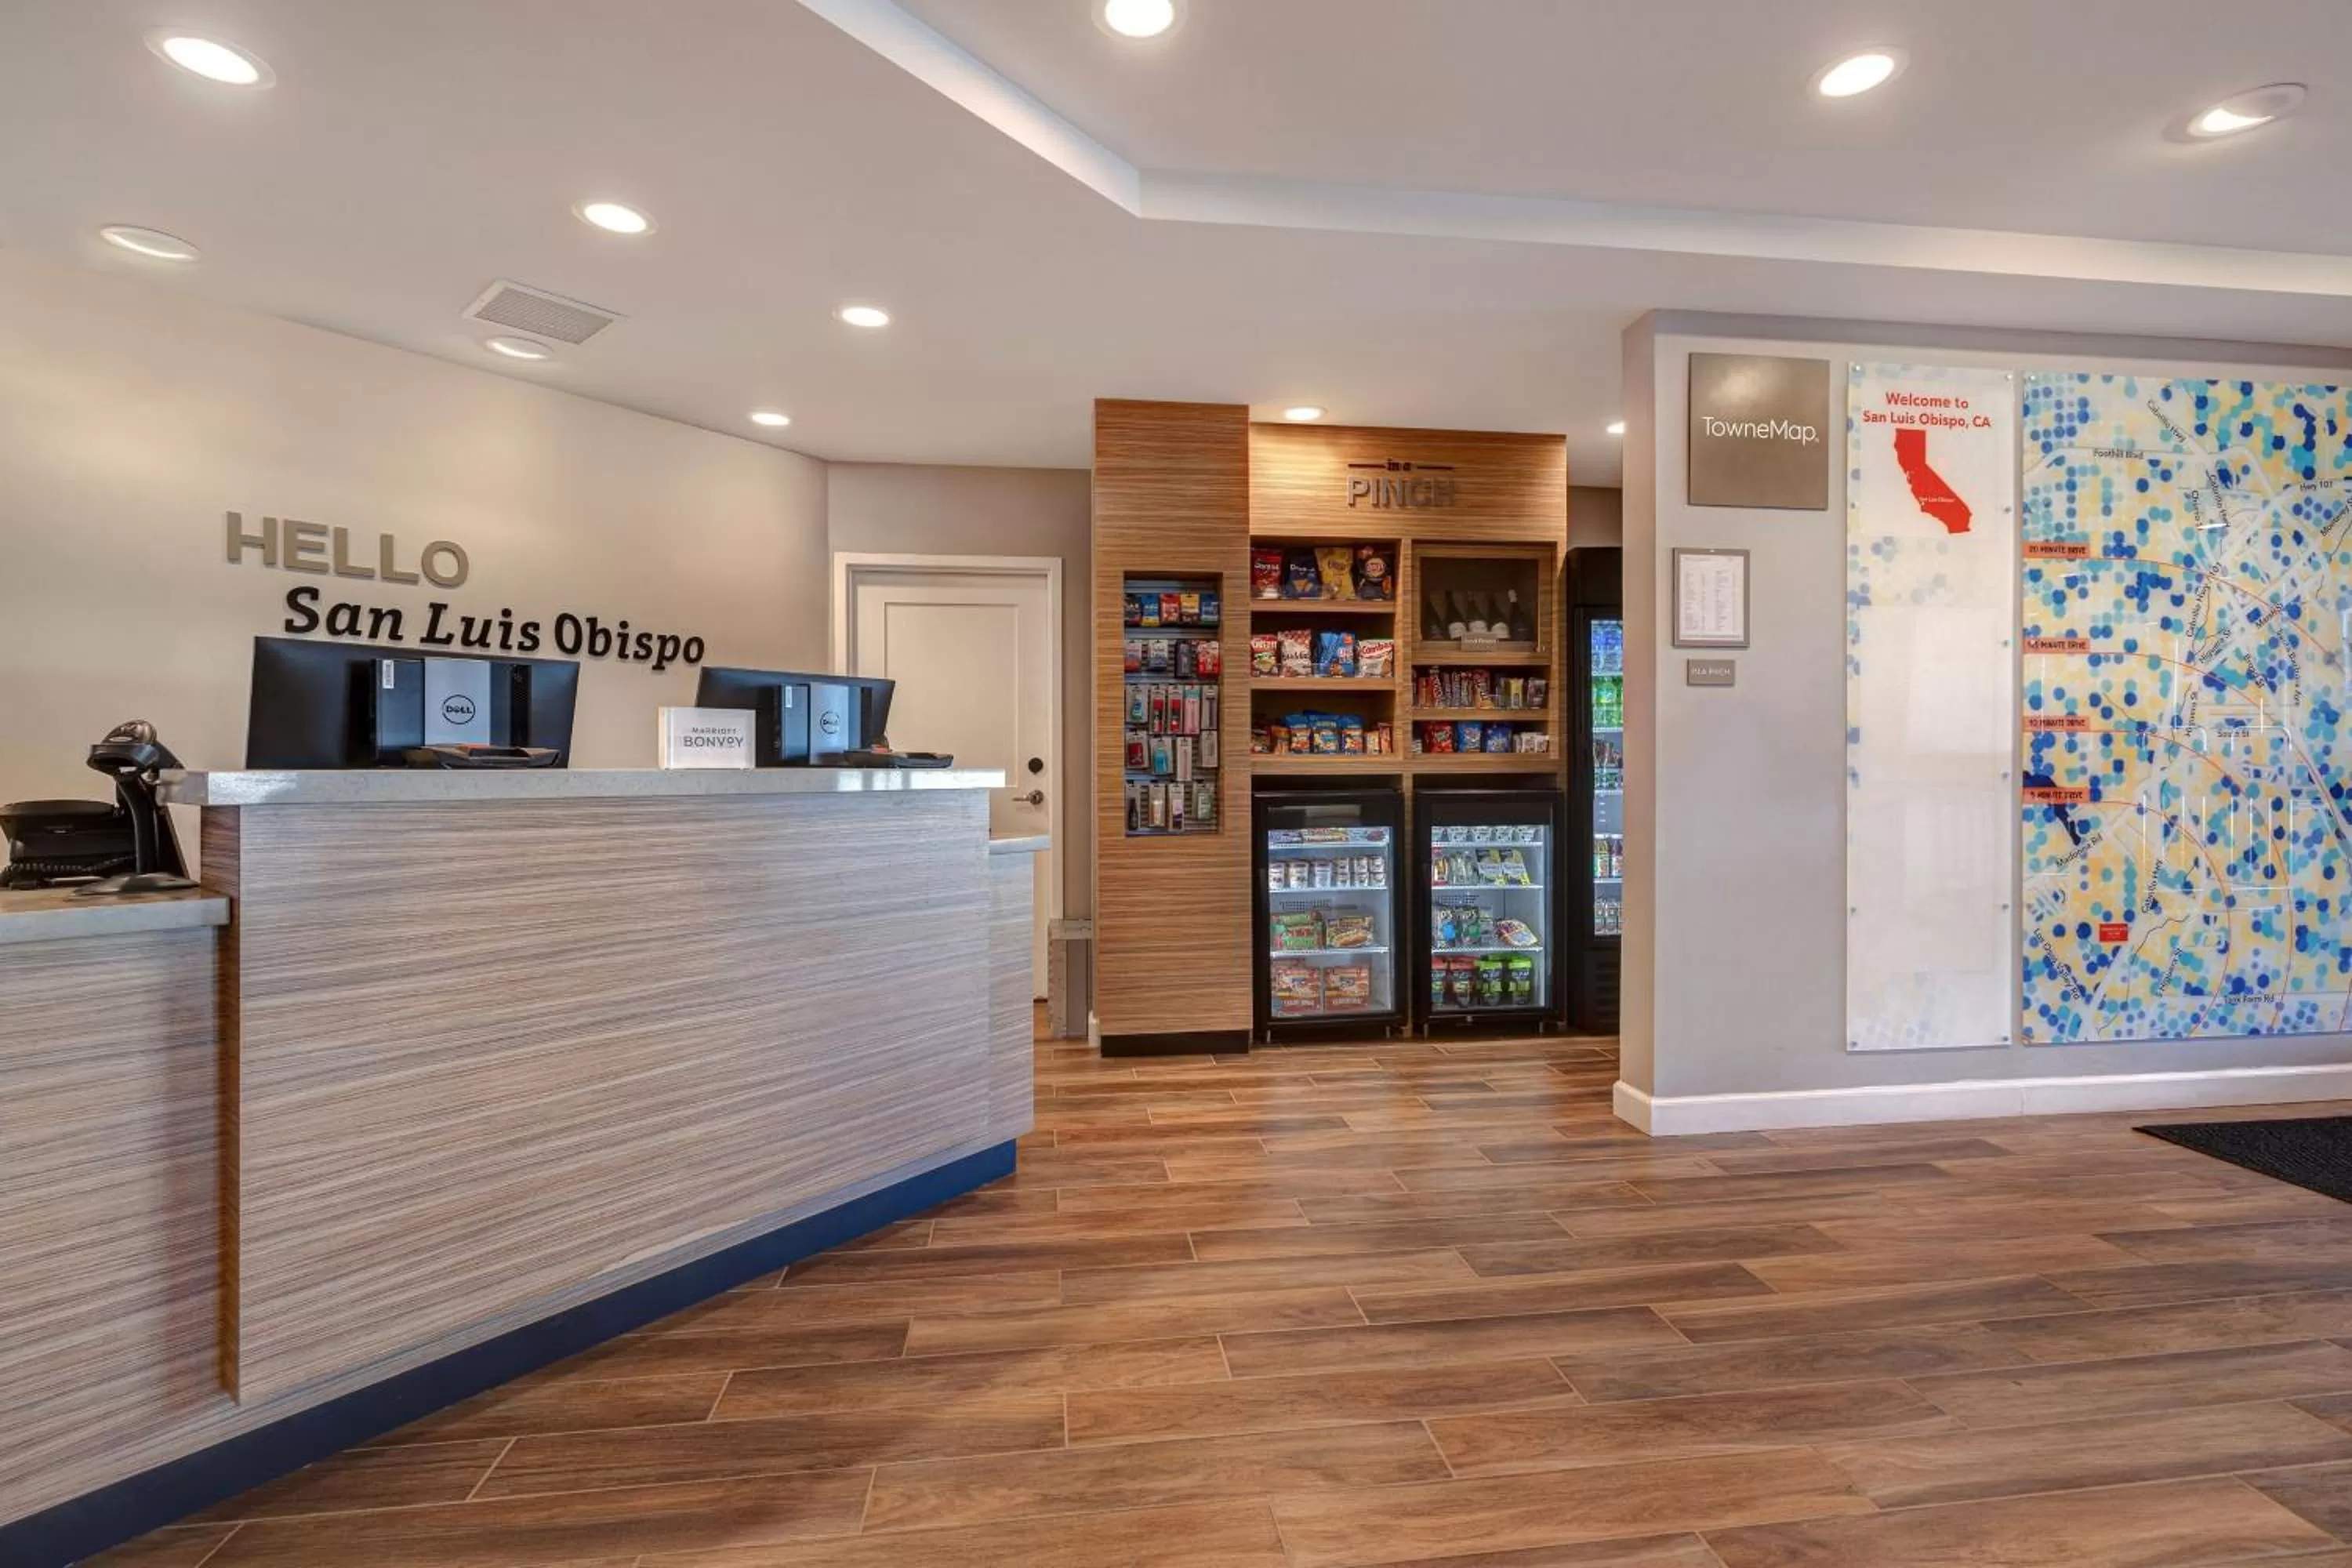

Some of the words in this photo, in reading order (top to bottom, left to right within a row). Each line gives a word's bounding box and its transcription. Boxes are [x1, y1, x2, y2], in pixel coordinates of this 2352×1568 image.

[1886, 392, 1951, 407] Welcome
[1955, 397, 1969, 408] to
[1863, 410, 1887, 423] San
[1891, 412, 1915, 424] Luis
[1919, 413, 1969, 430] Obispo,
[1973, 416, 1991, 427] CA
[1403, 462, 1410, 471] a
[1347, 475, 1455, 507] PINCH
[227, 510, 470, 589] HELLO
[2209, 561, 2223, 576] 101
[285, 586, 403, 641] San
[419, 601, 541, 652] Luis
[554, 612, 705, 670] Obispo
[446, 705, 473, 714] DELL
